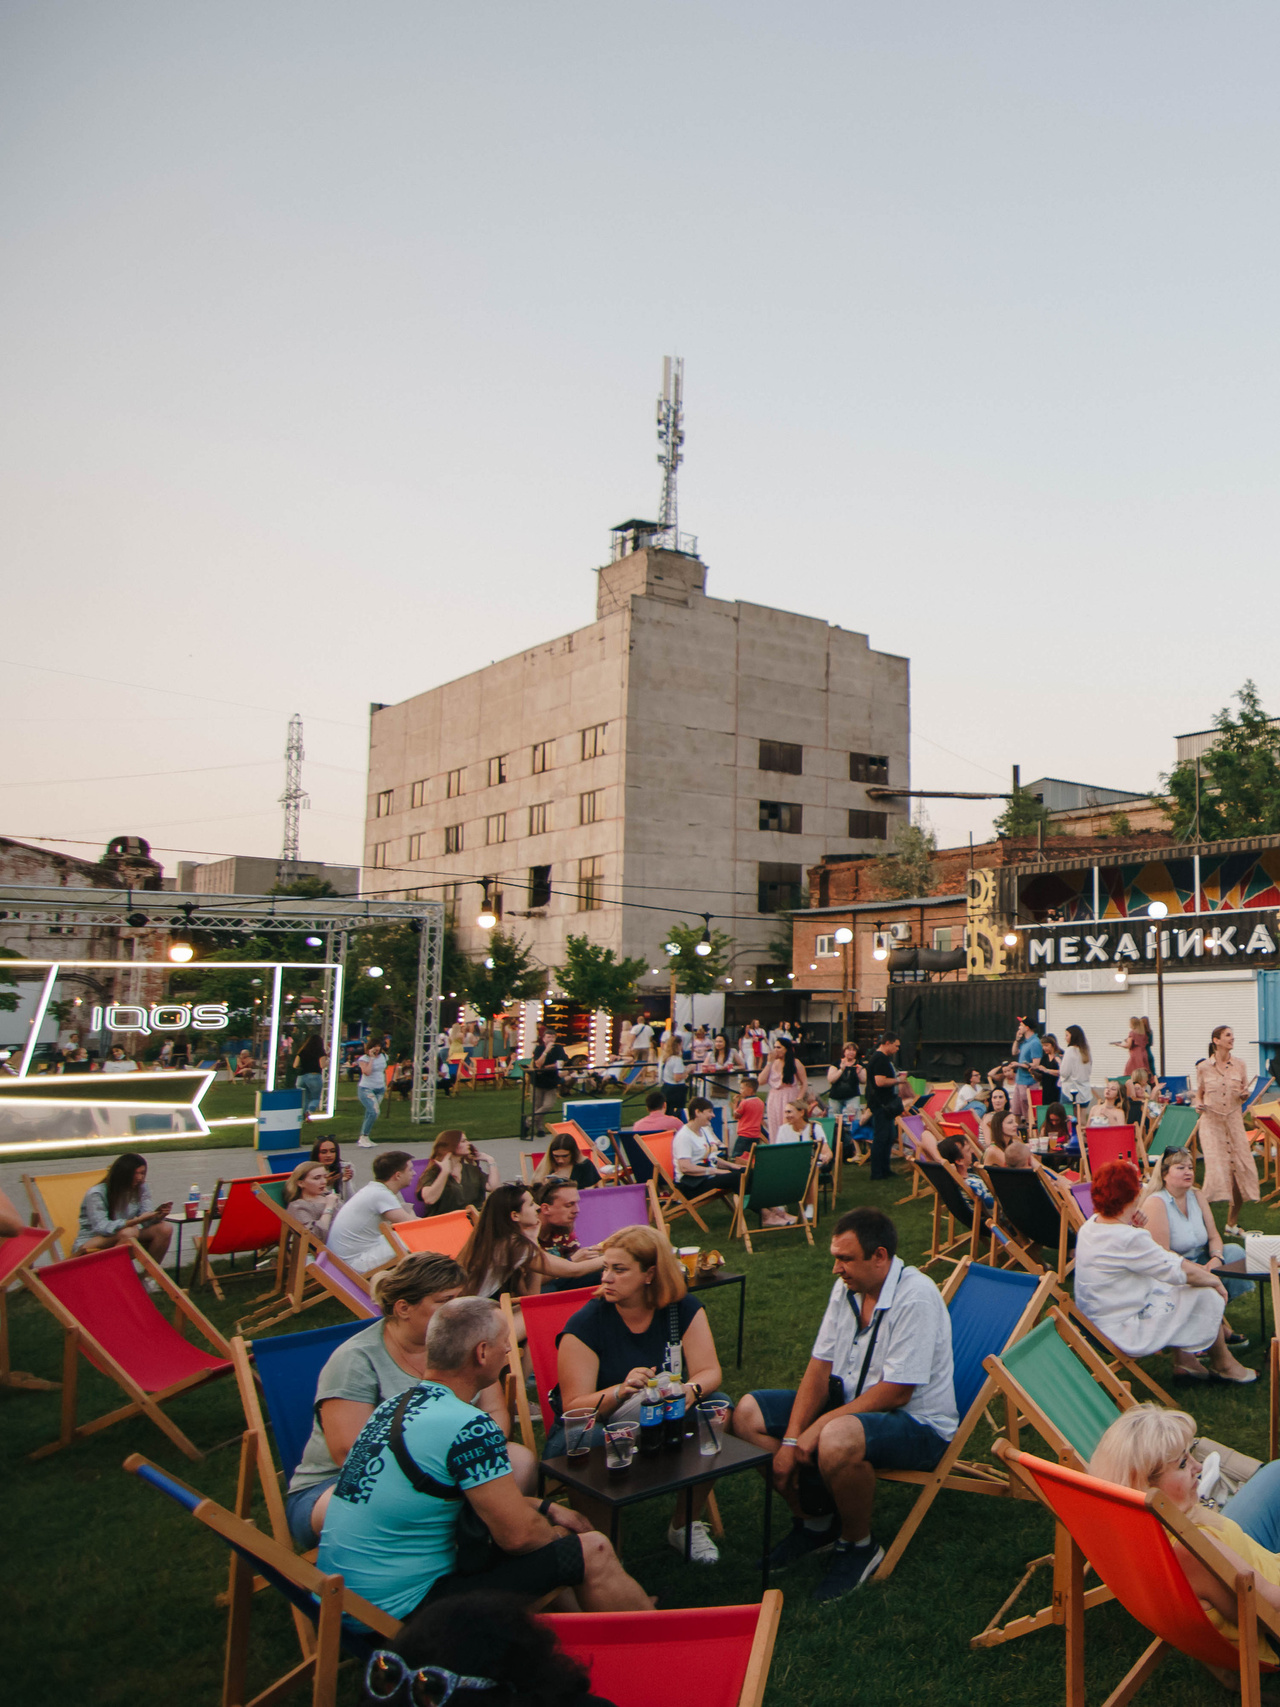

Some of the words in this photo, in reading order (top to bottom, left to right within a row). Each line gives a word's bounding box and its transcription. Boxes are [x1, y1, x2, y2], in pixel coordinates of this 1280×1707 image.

[1029, 923, 1277, 965] МЕХАНИКА
[92, 1004, 229, 1035] IQOS
[453, 1446, 486, 1466] THE
[465, 1454, 510, 1481] WA
